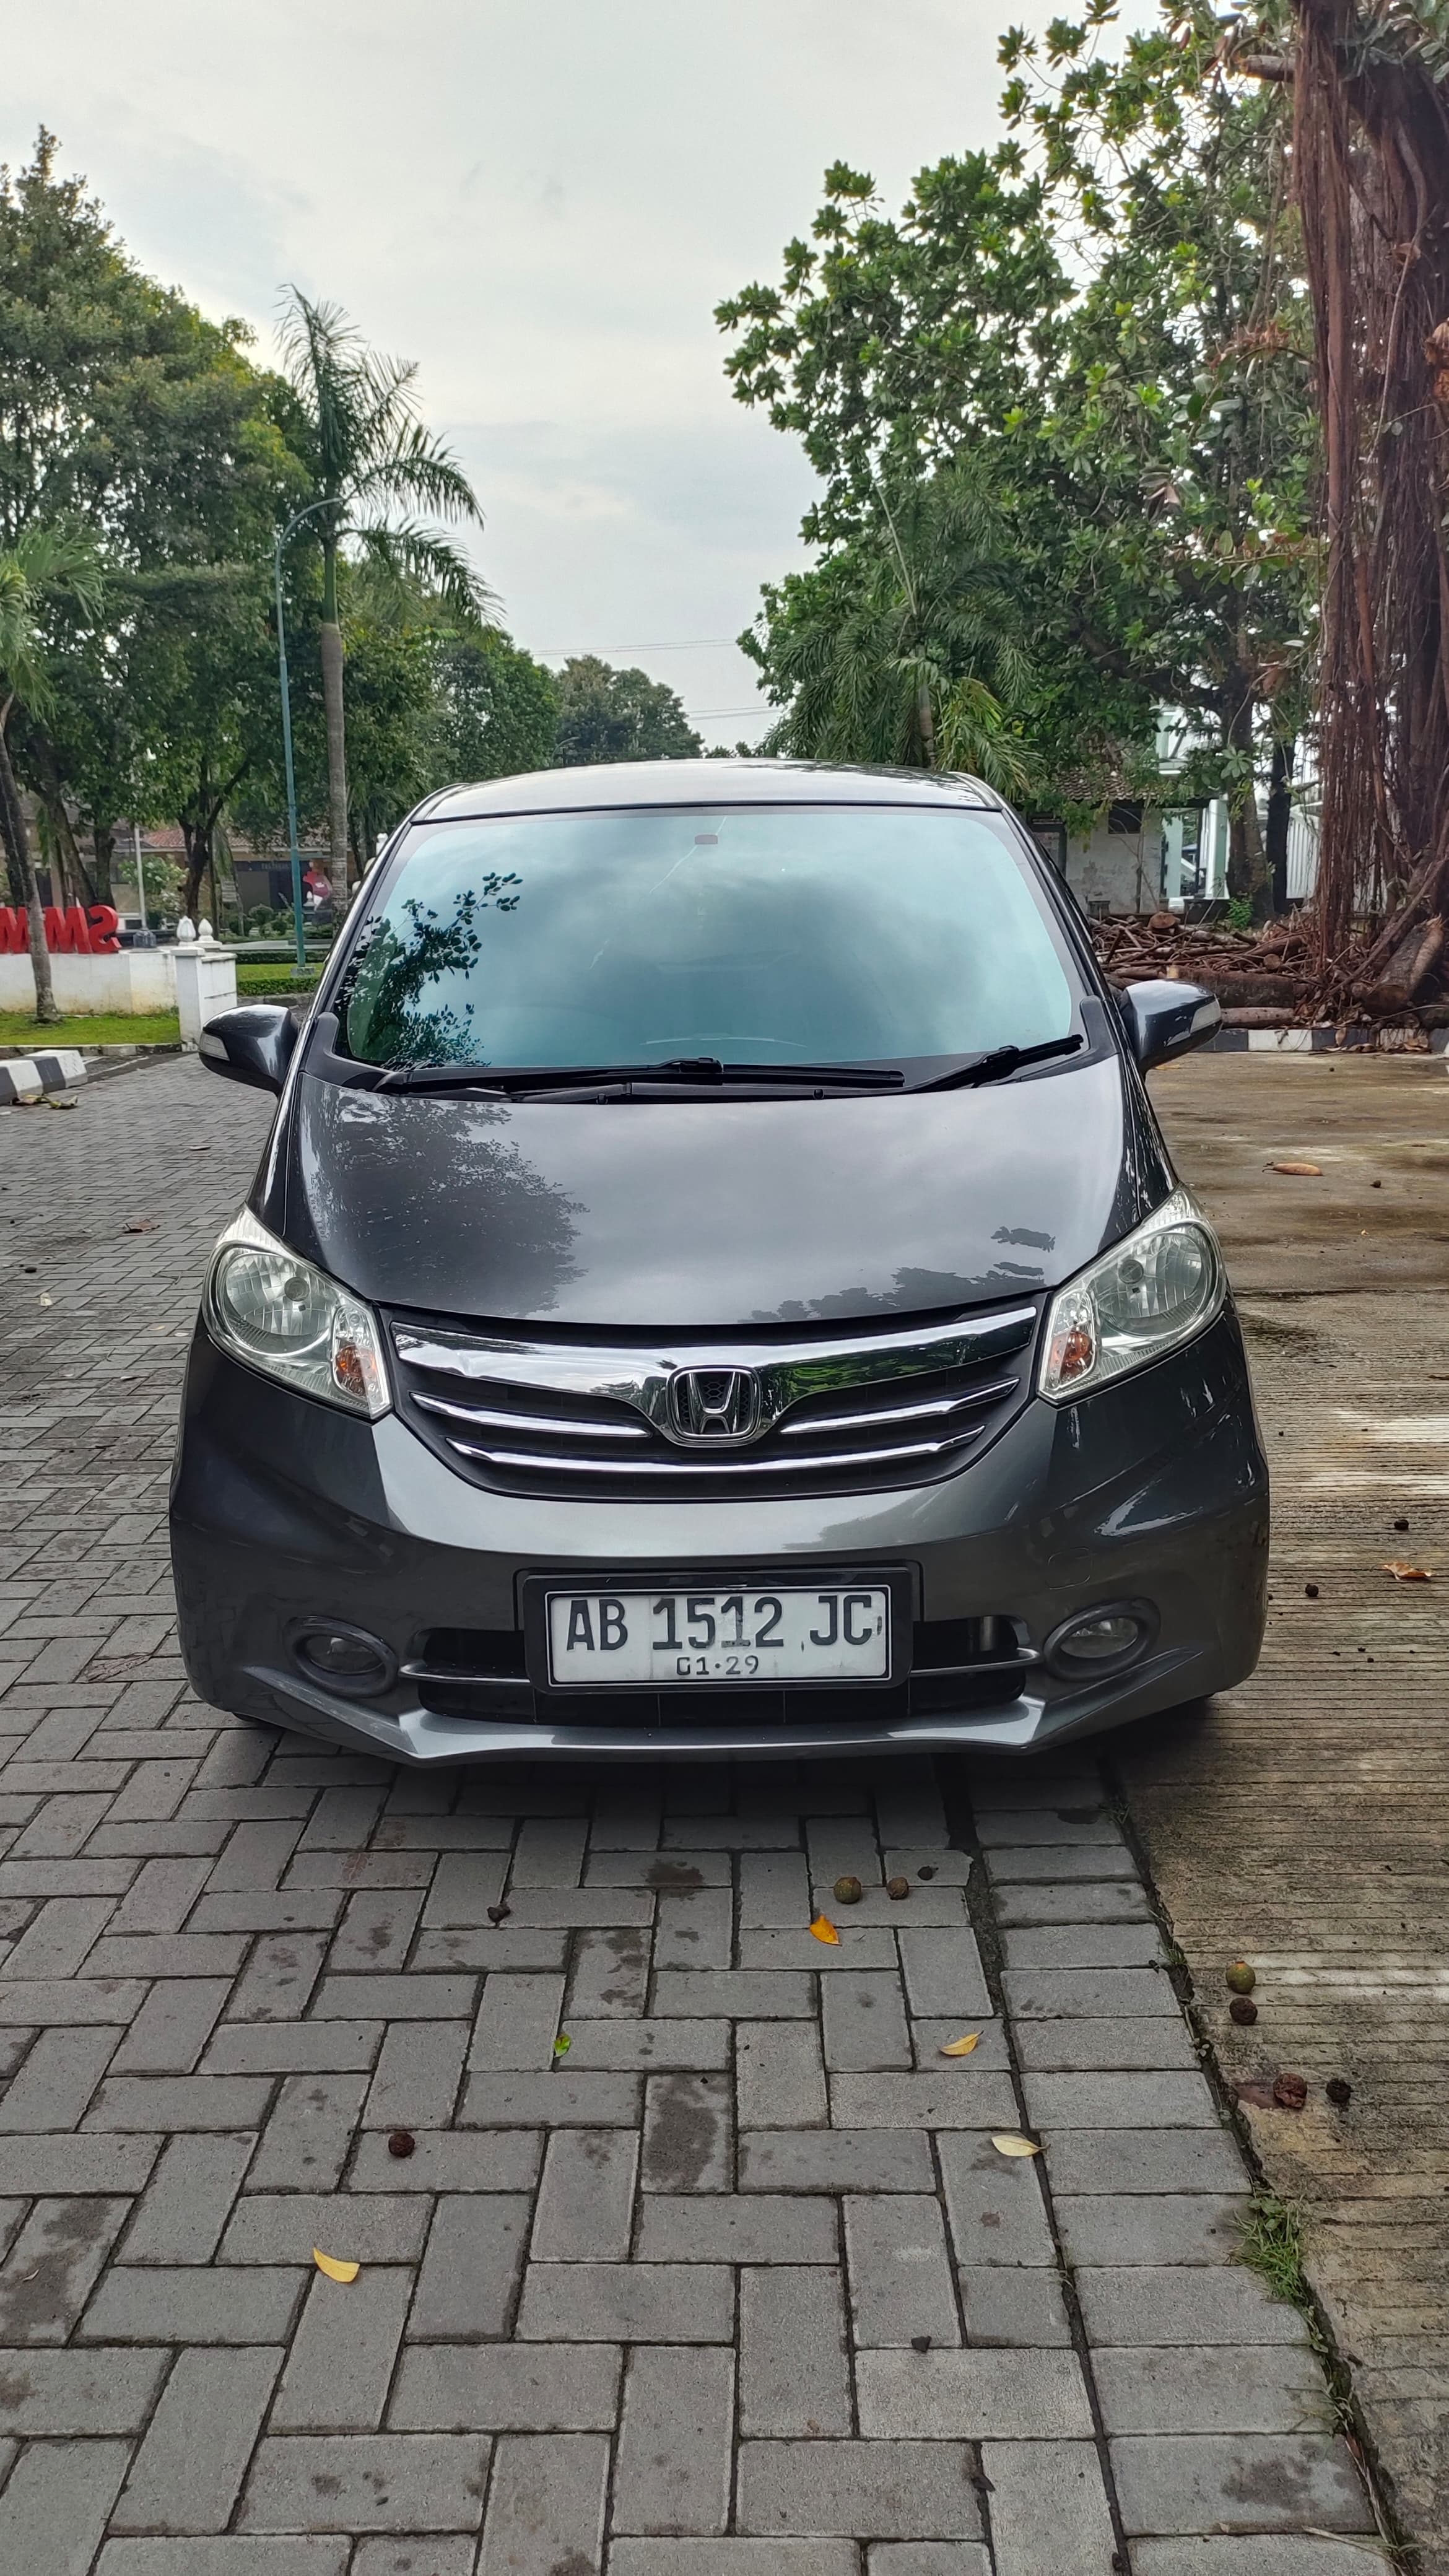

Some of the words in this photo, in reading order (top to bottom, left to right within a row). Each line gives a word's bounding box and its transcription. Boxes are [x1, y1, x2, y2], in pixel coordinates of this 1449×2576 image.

[566, 1598, 628, 1651] AB
[651, 1596, 784, 1650] 1512
[809, 1595, 872, 1646] JC
